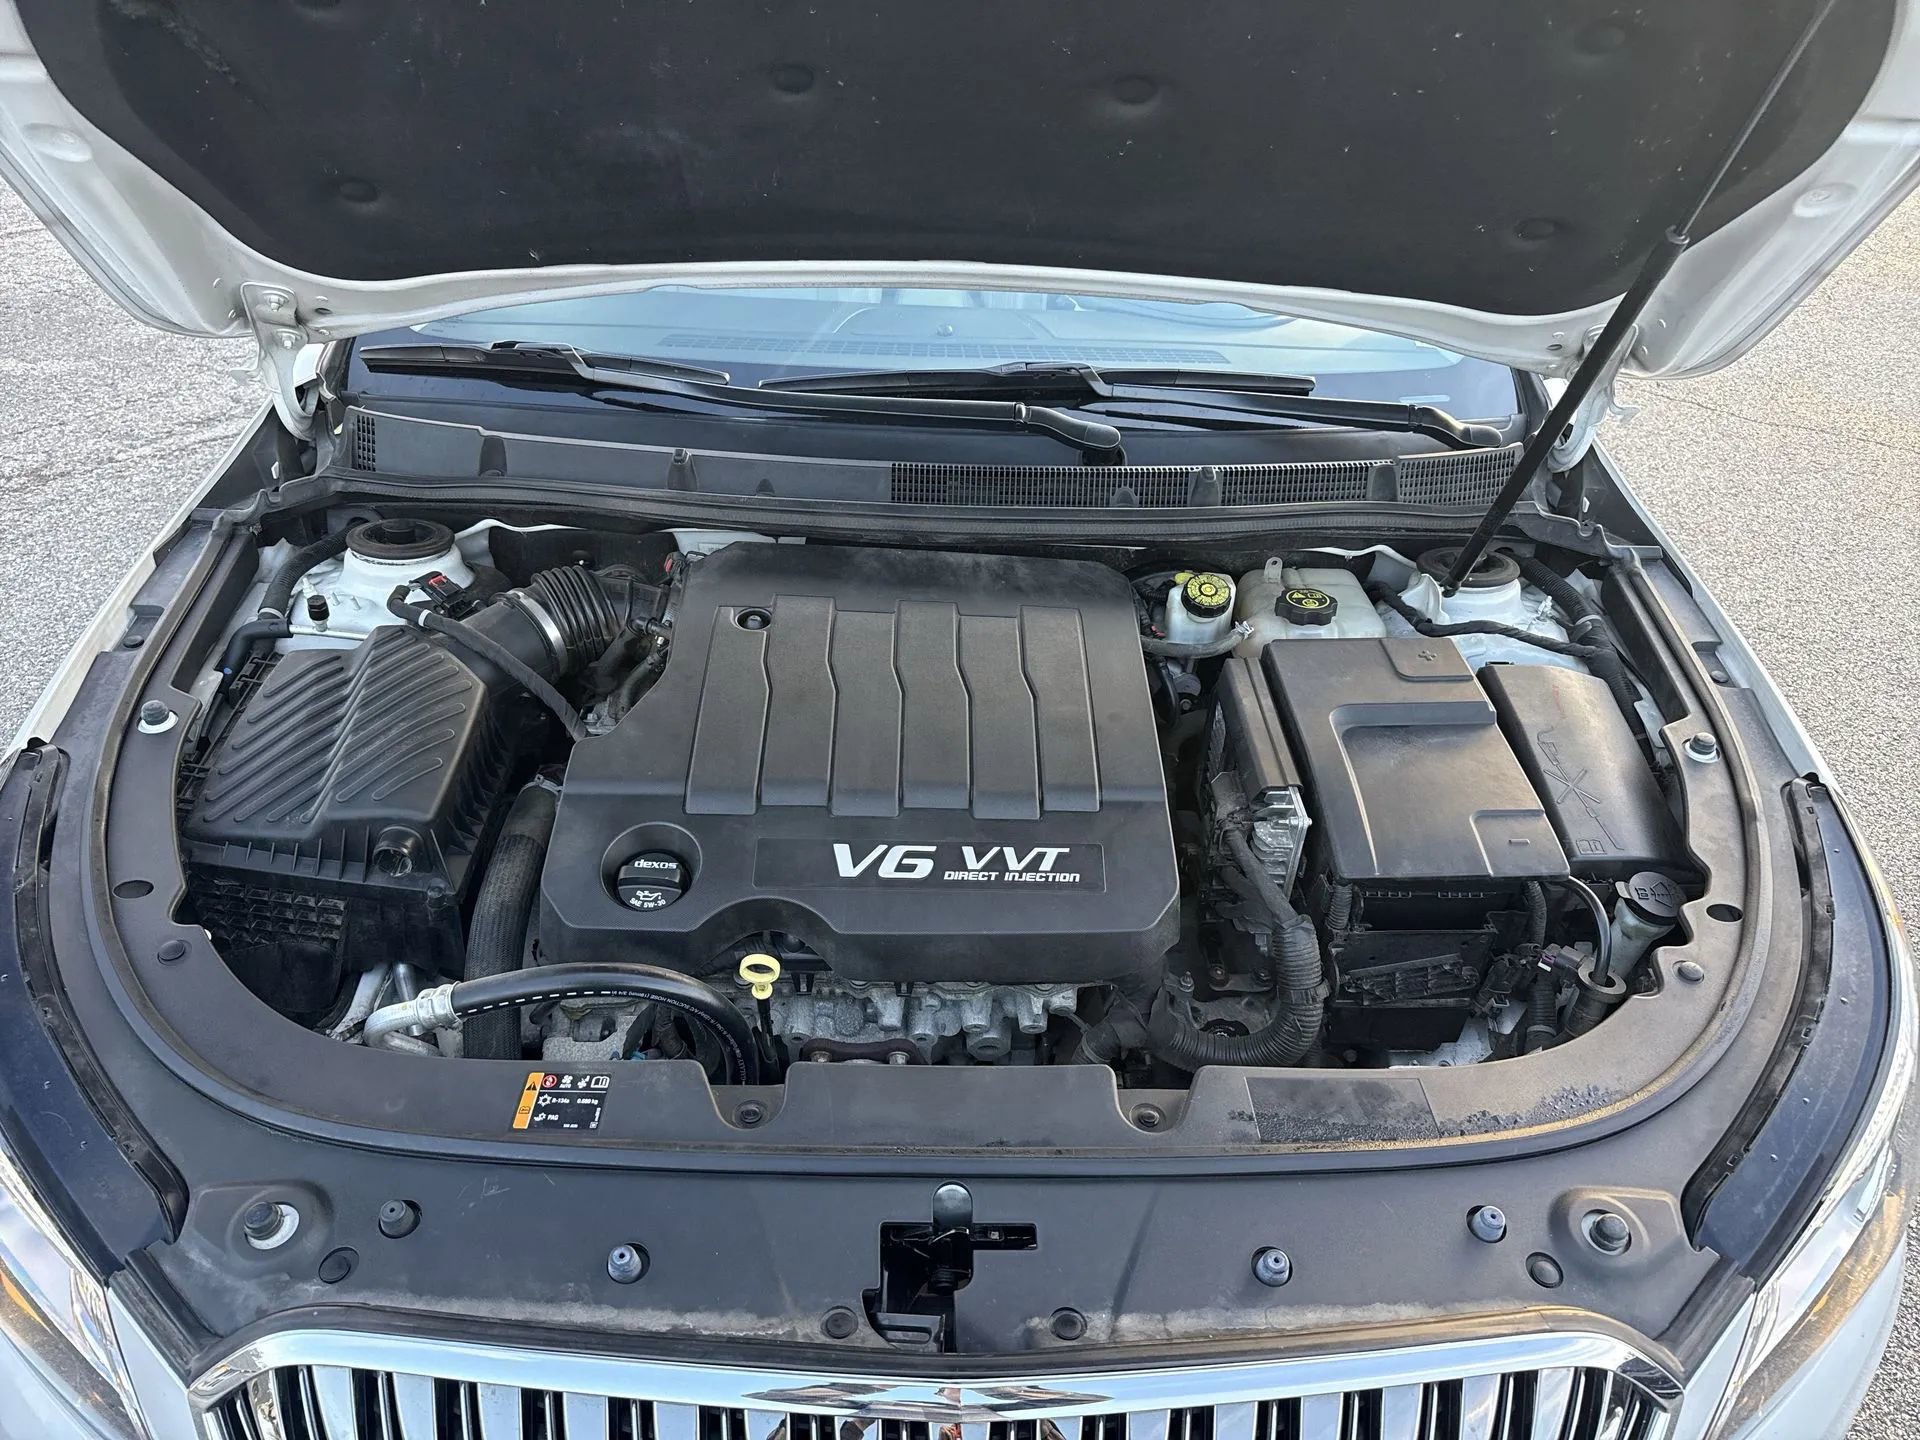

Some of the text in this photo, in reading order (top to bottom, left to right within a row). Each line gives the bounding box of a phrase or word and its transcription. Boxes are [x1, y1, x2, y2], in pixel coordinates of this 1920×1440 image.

[634, 858, 679, 869] dexos
[833, 843, 1070, 879] V6 VVT
[944, 870, 1080, 883] DIRECT INJECTION
[629, 897, 666, 908] SAE 5W-30
[649, 993, 667, 1002] HOSE
[666, 997, 690, 1010] SUCTION
